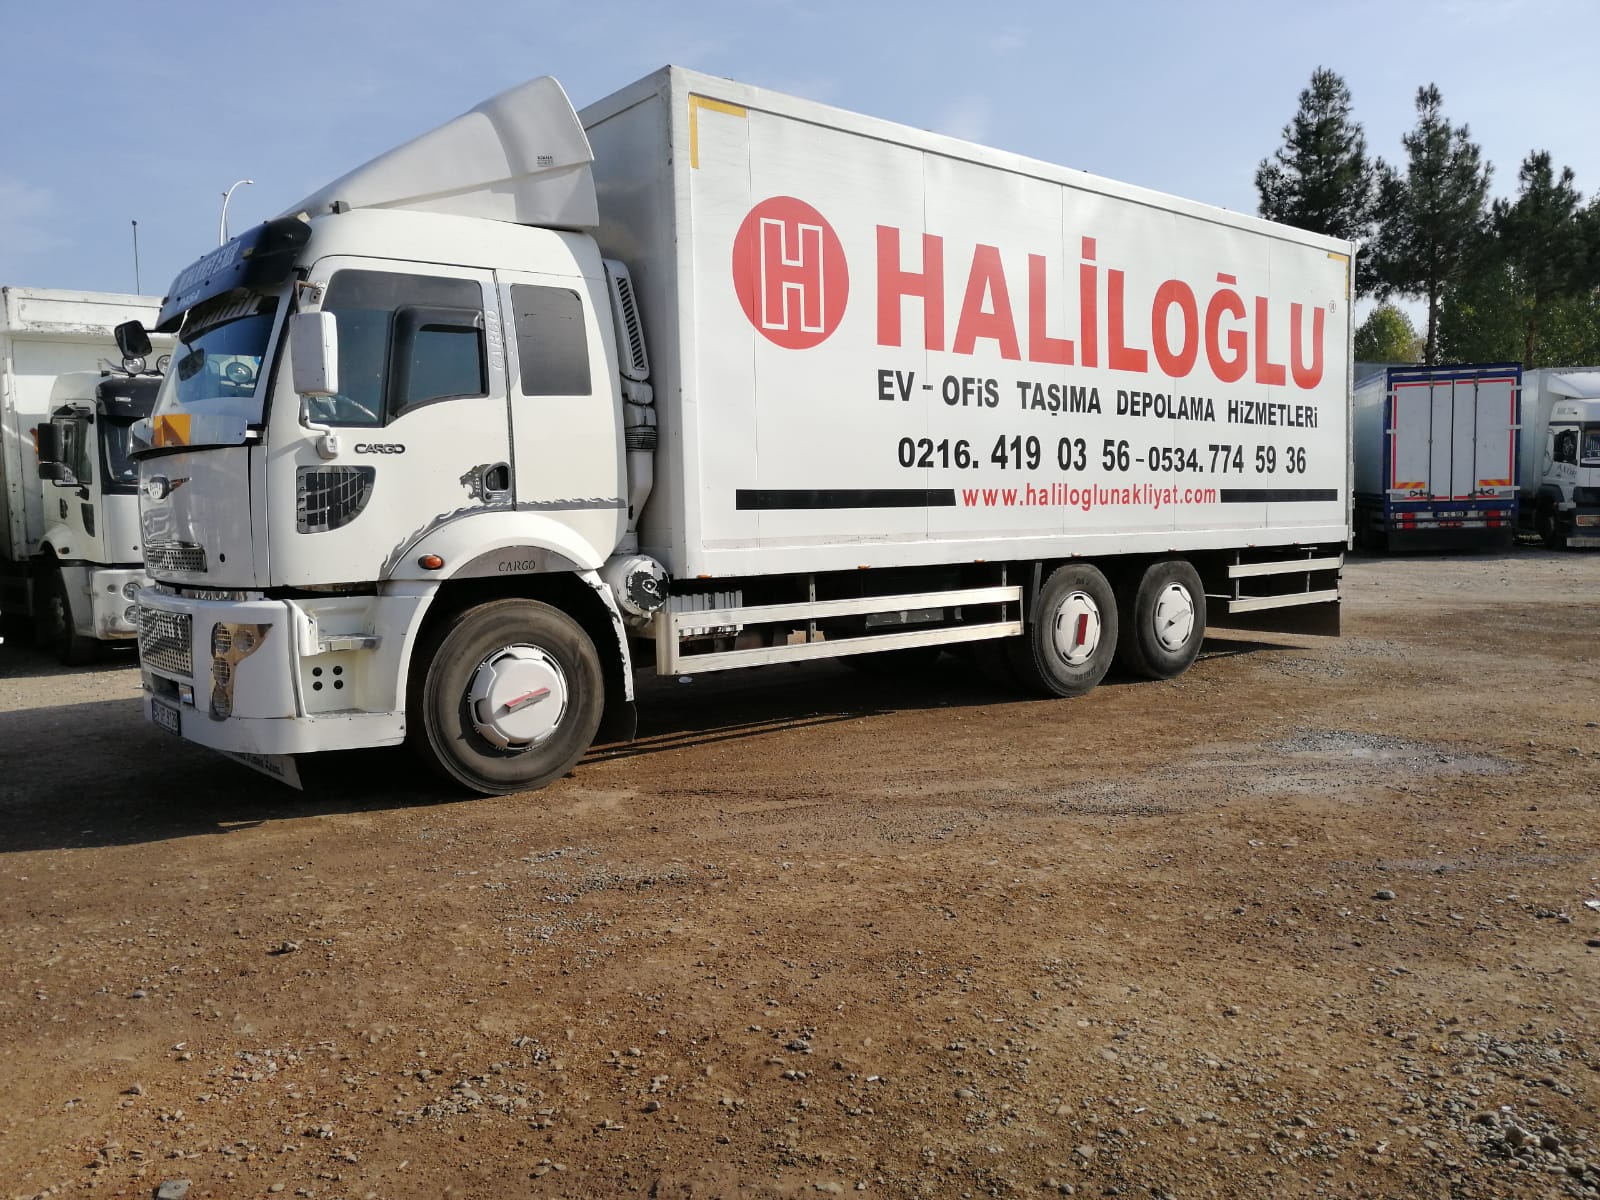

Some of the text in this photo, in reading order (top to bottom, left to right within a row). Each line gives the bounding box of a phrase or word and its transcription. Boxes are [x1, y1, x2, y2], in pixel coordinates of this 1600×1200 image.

[877, 369, 915, 402] EV
[1016, 381, 1102, 417] TAŞIMA
[1116, 389, 1216, 422] DEPOLAMA
[354, 443, 406, 455] CARGO
[898, 437, 979, 469] 0216.
[990, 434, 1041, 471] 419
[1057, 437, 1087, 472] 03
[1255, 445, 1277, 474] 59
[1285, 446, 1306, 474] 36
[962, 483, 1217, 512] www.haliloglunakliyat.com
[498, 560, 536, 572] CARGO
